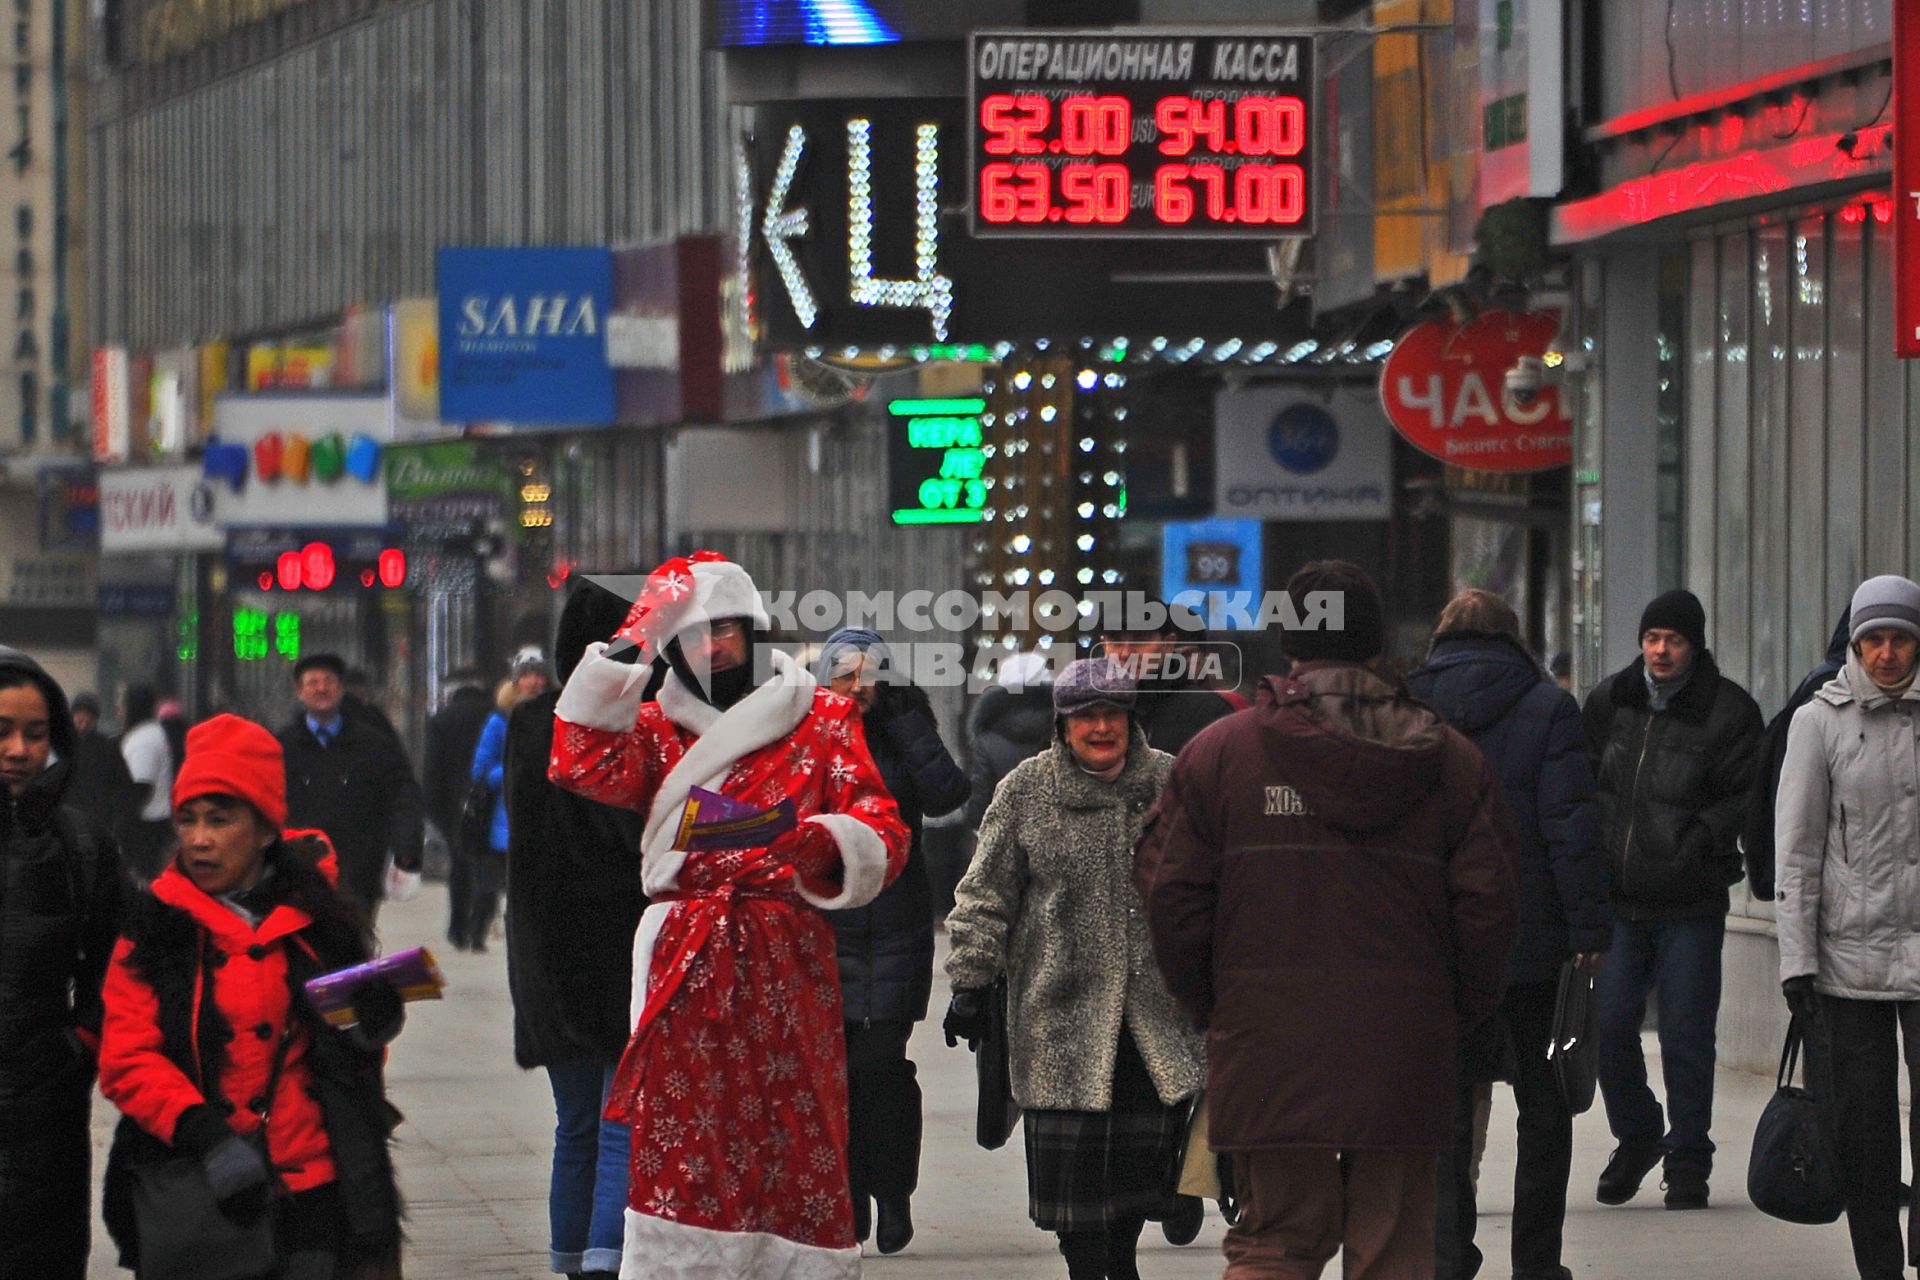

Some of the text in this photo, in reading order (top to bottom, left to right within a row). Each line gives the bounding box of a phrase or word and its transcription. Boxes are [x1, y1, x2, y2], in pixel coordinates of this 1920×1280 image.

[979, 42, 1298, 83] ОПЕРАЦИОННАЯ КАССА
[980, 95, 1306, 157] 52.00 USD 54.00
[980, 162, 1132, 225] 63.50
[1154, 162, 1306, 225] 67.00
[1398, 371, 1574, 429] ЧАС
